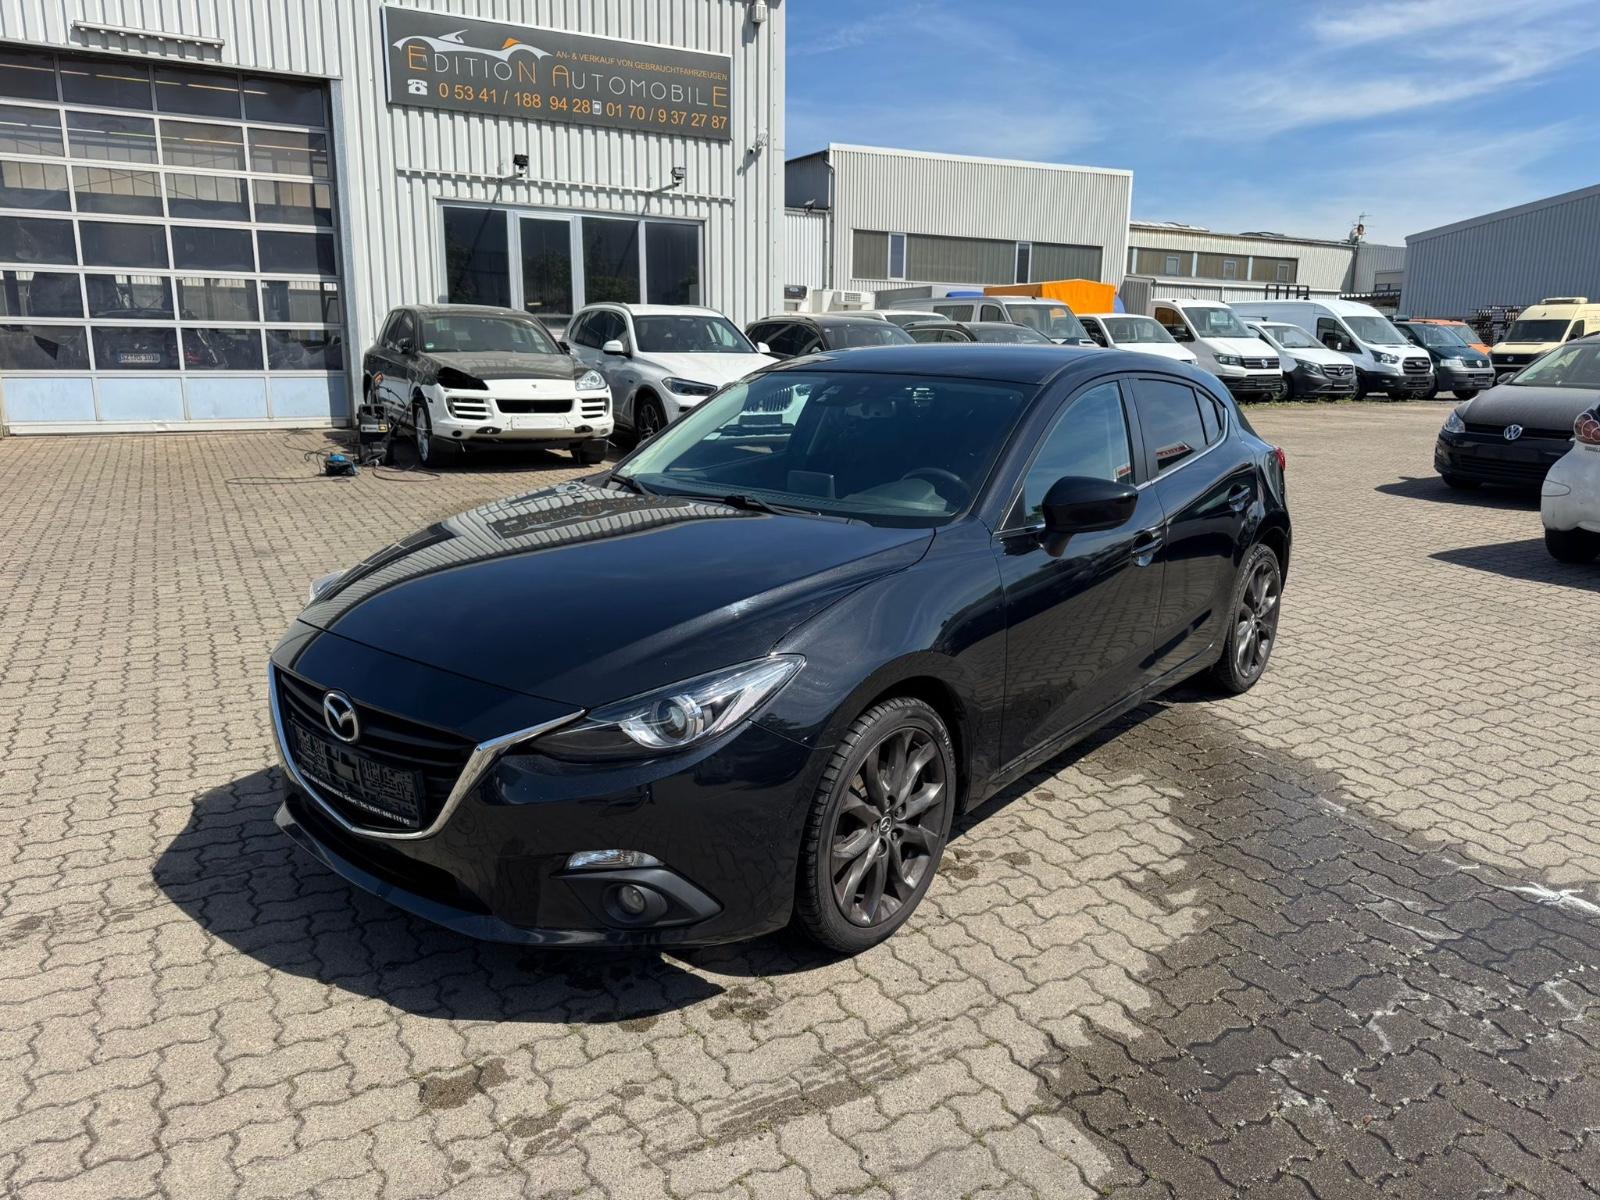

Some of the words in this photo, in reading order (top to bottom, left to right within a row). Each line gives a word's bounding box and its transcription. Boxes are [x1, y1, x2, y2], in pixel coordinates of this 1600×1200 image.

[408, 45, 537, 84] EDITION
[552, 64, 728, 108] AUTOMOBILE
[556, 50, 571, 59] AN-
[571, 52, 578, 61] &
[579, 54, 615, 65] VERKAUF
[616, 59, 634, 69] VON
[635, 61, 728, 81] GEBRAUCHTFAHRZEUGEN
[439, 82, 449, 98] 0
[454, 84, 474, 101] 53
[479, 87, 497, 103] 41
[514, 92, 542, 108] 188
[550, 95, 568, 111] 94
[572, 98, 591, 114] 28
[606, 102, 623, 118] 01
[628, 105, 645, 120] 70
[658, 109, 667, 123] 9
[671, 110, 688, 125] 37
[691, 112, 707, 127] 27
[711, 115, 728, 130] 87
